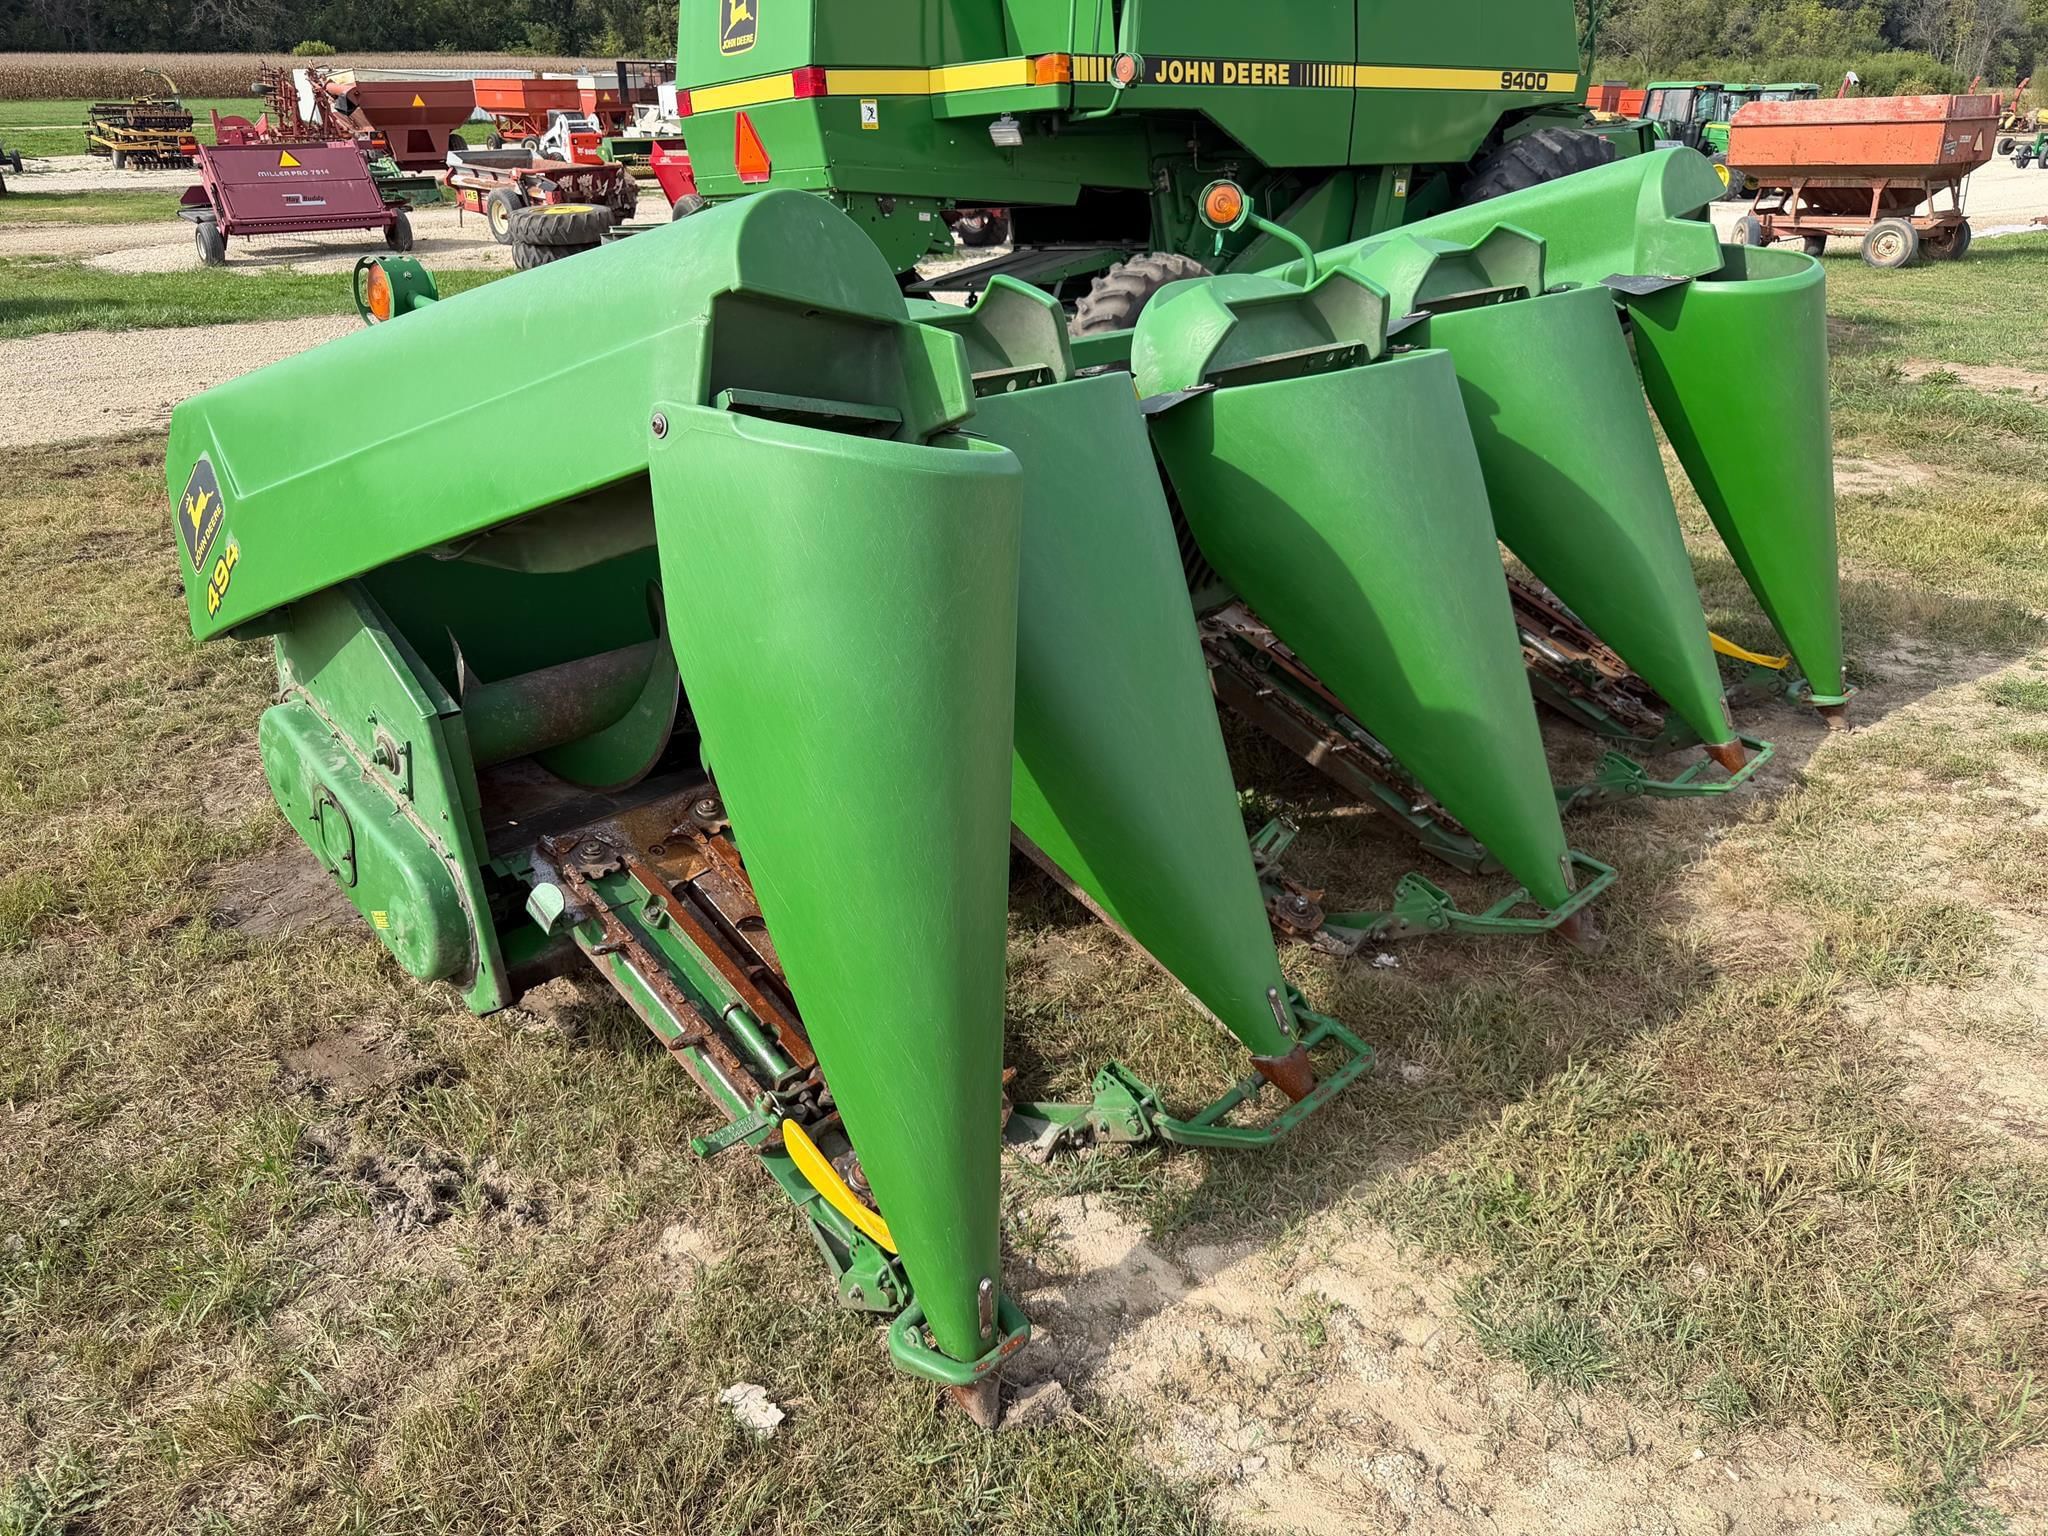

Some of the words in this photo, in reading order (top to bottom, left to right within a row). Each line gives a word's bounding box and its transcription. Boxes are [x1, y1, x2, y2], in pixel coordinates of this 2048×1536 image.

[722, 38, 737, 49] JOHN
[737, 33, 754, 46] DEERE
[1155, 60, 1215, 83] JOHN
[1222, 62, 1290, 85] DEERE
[1501, 71, 1548, 90] 9400
[195, 535, 208, 567] JOHN
[204, 503, 222, 540] DEERE
[208, 544, 239, 618] 494
